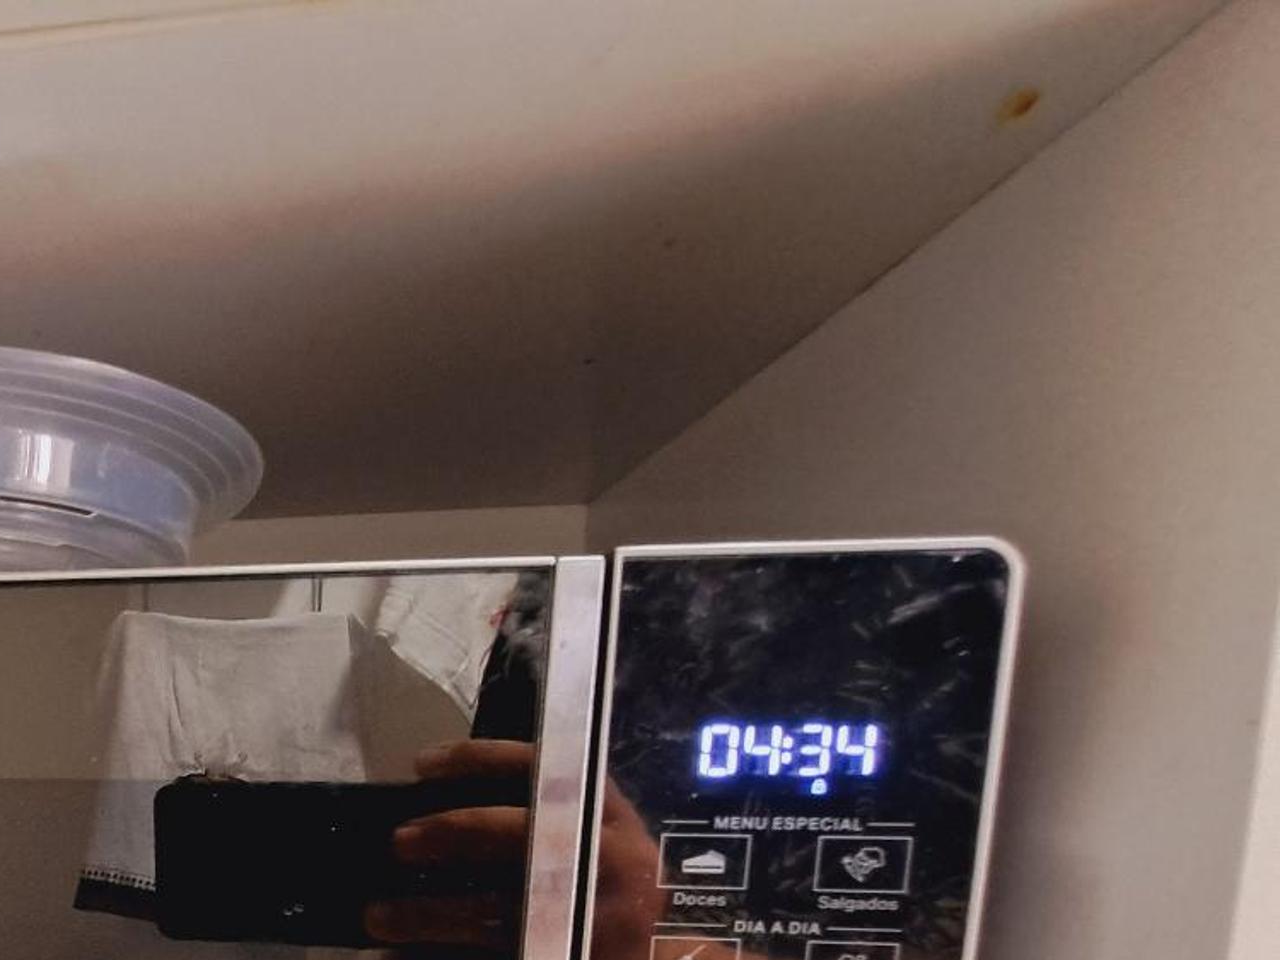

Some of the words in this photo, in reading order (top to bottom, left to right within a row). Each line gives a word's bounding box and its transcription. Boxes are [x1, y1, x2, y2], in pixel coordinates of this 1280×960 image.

[698, 723, 879, 776] 04:34
[713, 816, 767, 830] MENU
[772, 817, 863, 831] ESPECIAL
[673, 892, 727, 906] Doces
[818, 896, 899, 912] Salgados
[734, 920, 766, 933] DIA
[771, 922, 786, 934] A
[789, 922, 821, 935] DIA
